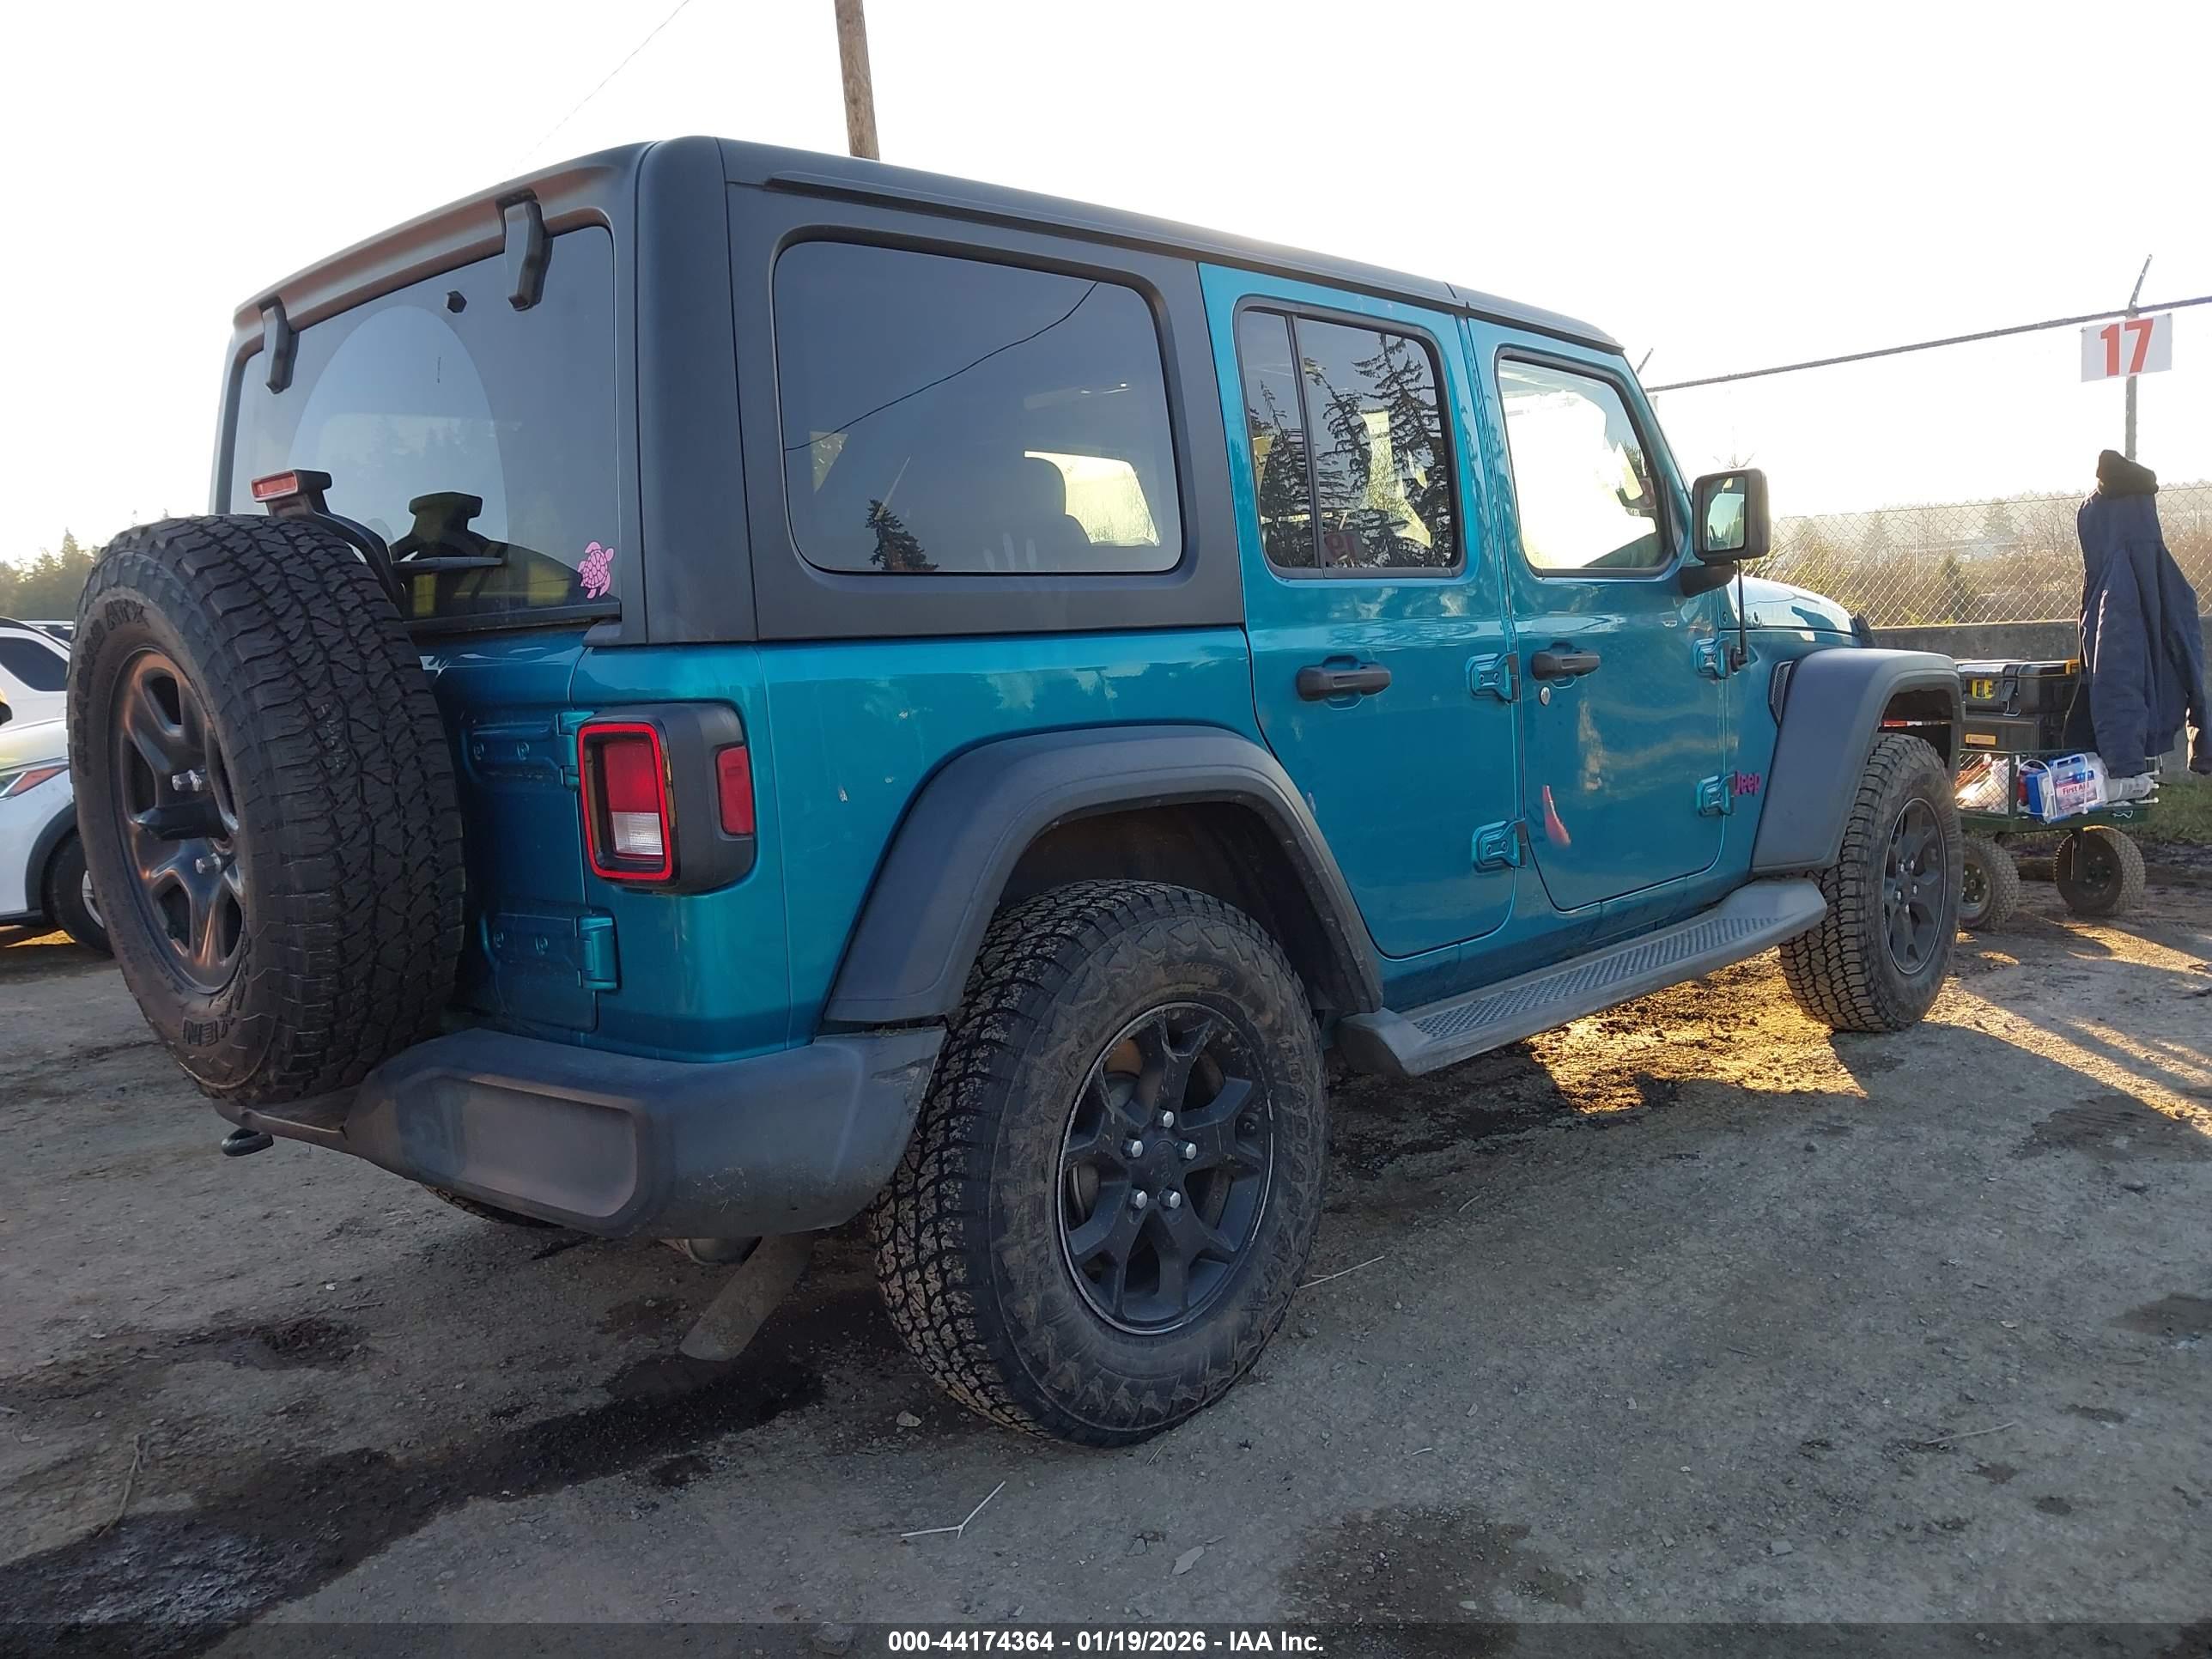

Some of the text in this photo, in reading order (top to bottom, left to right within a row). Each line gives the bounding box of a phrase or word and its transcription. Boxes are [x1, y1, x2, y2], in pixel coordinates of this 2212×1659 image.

[2100, 318, 2154, 377] 17
[1735, 769, 1761, 796] Jeep
[2063, 786, 2078, 795] First
